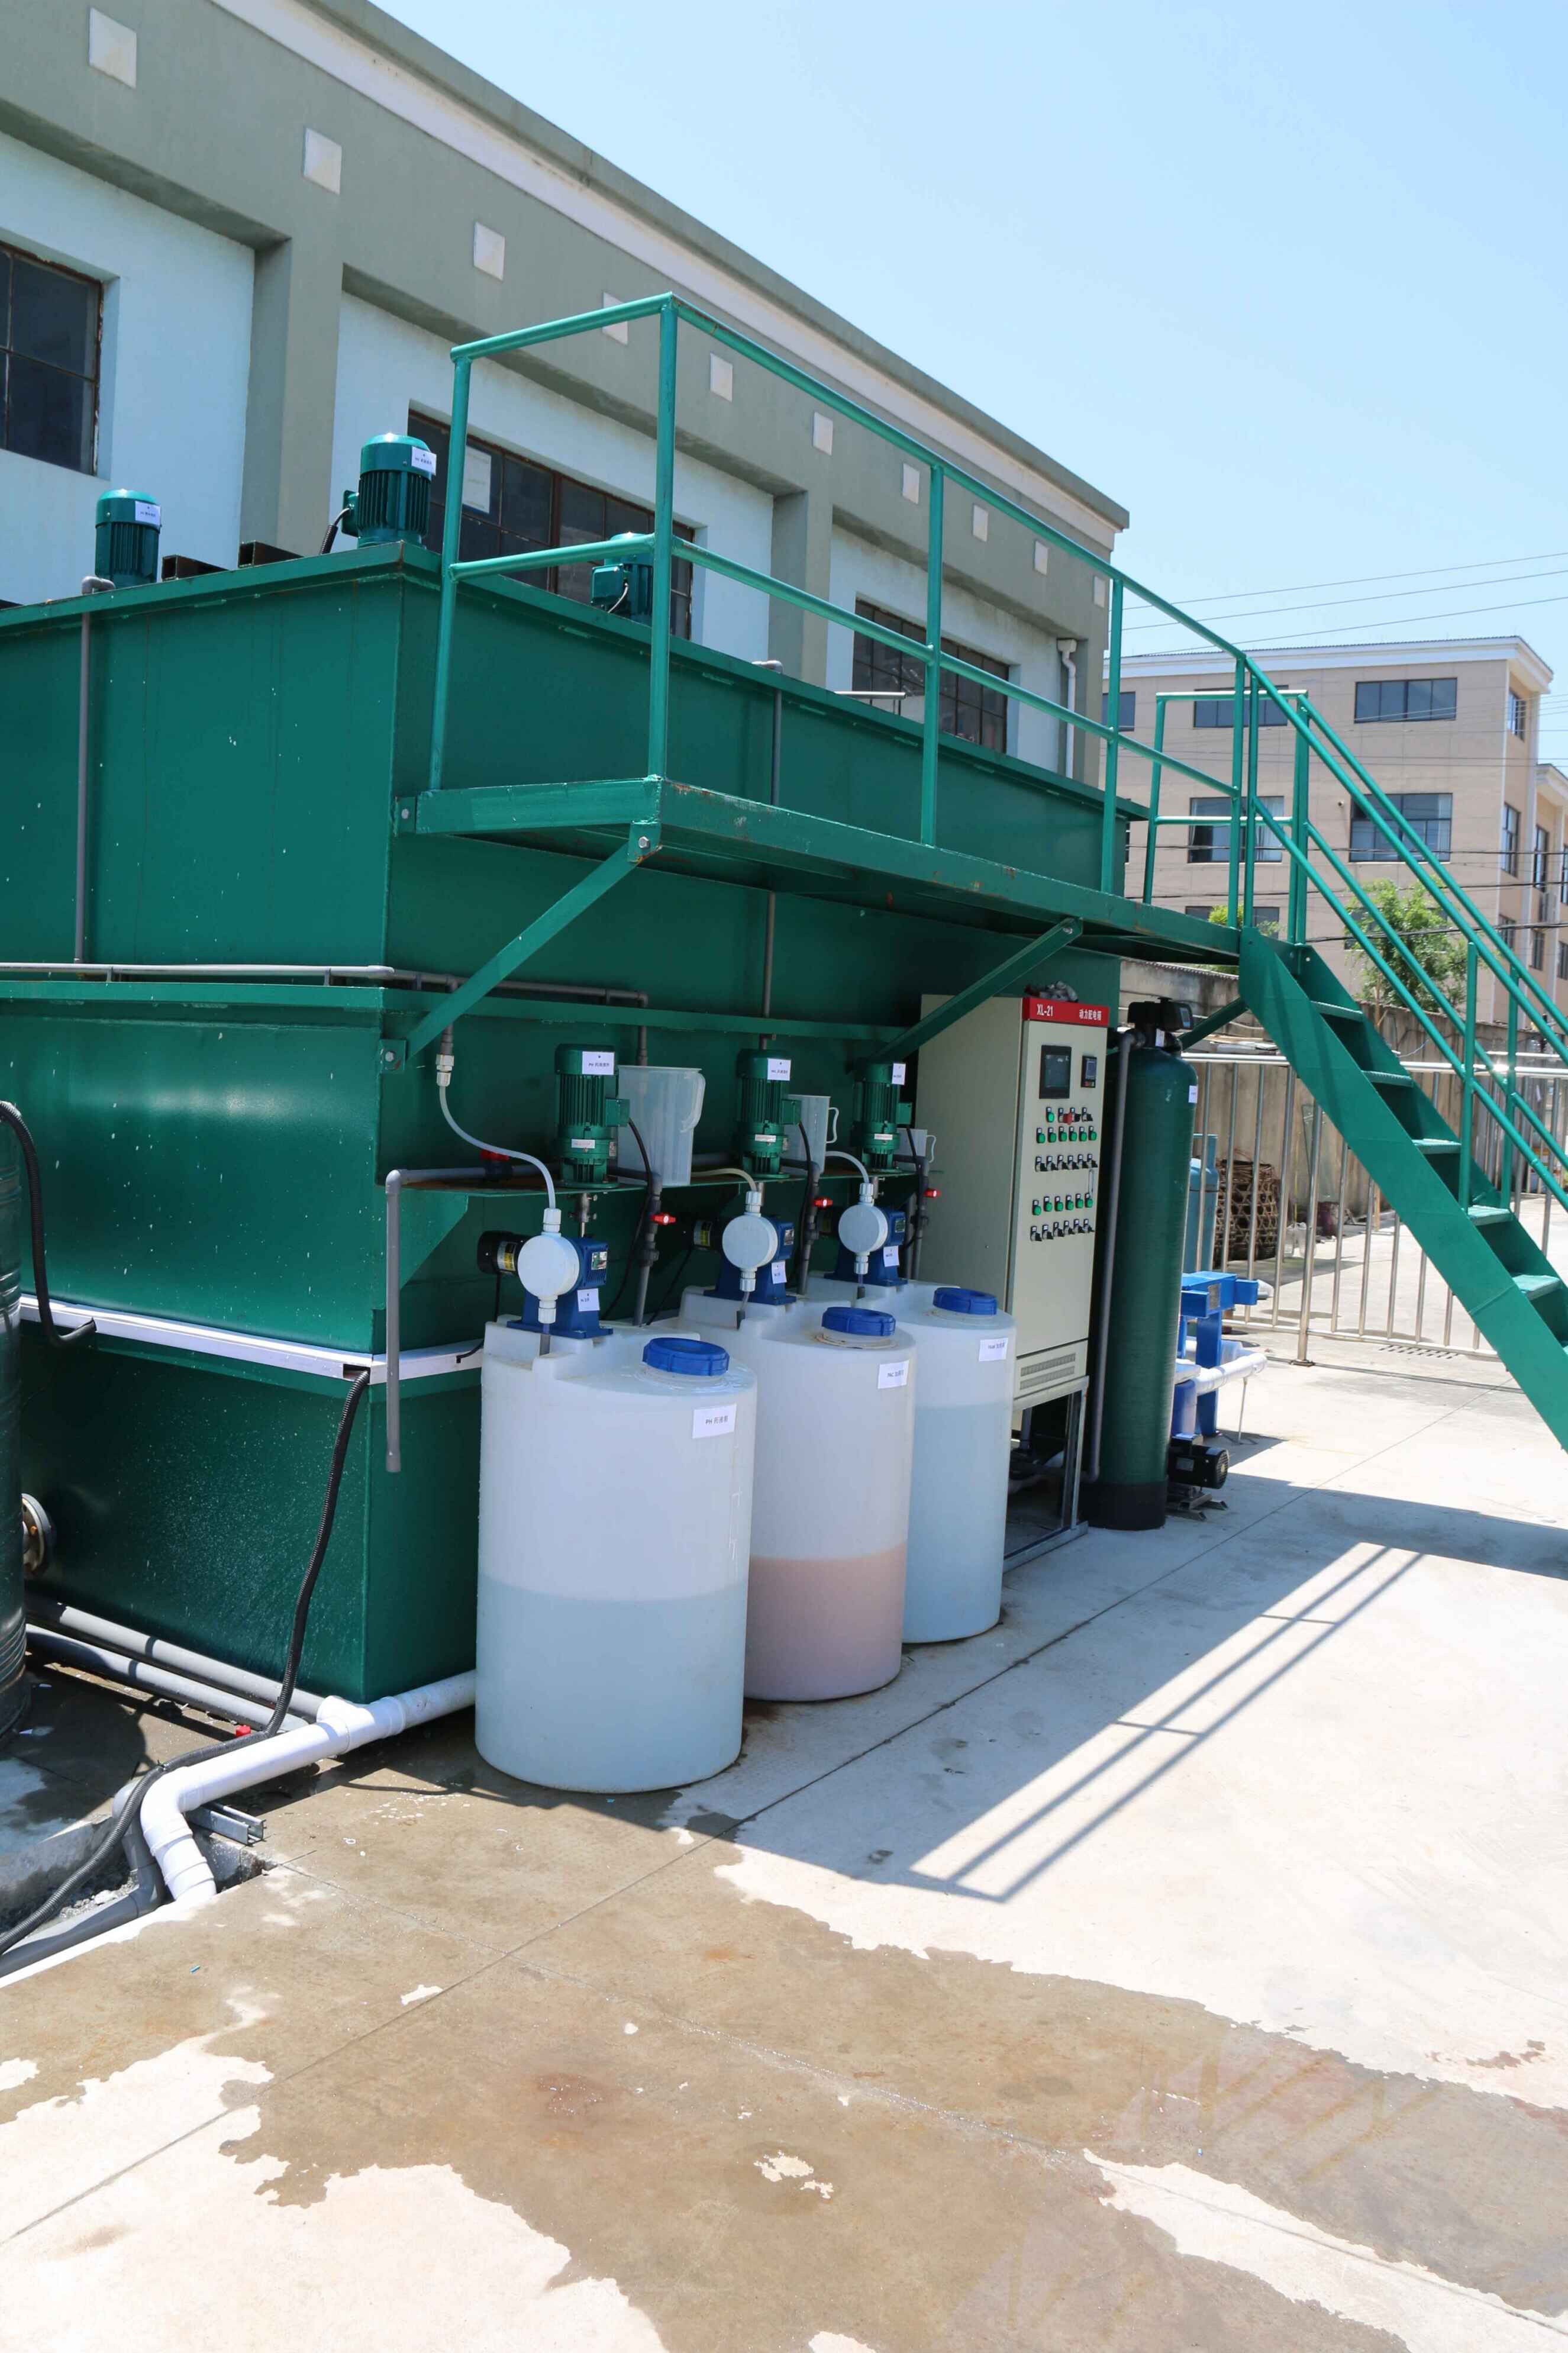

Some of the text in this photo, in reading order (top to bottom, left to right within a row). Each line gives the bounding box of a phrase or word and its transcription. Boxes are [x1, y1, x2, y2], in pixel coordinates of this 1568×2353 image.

[1037, 1004, 1053, 1017] XL-21
[1079, 1008, 1102, 1021] 动力配电箱
